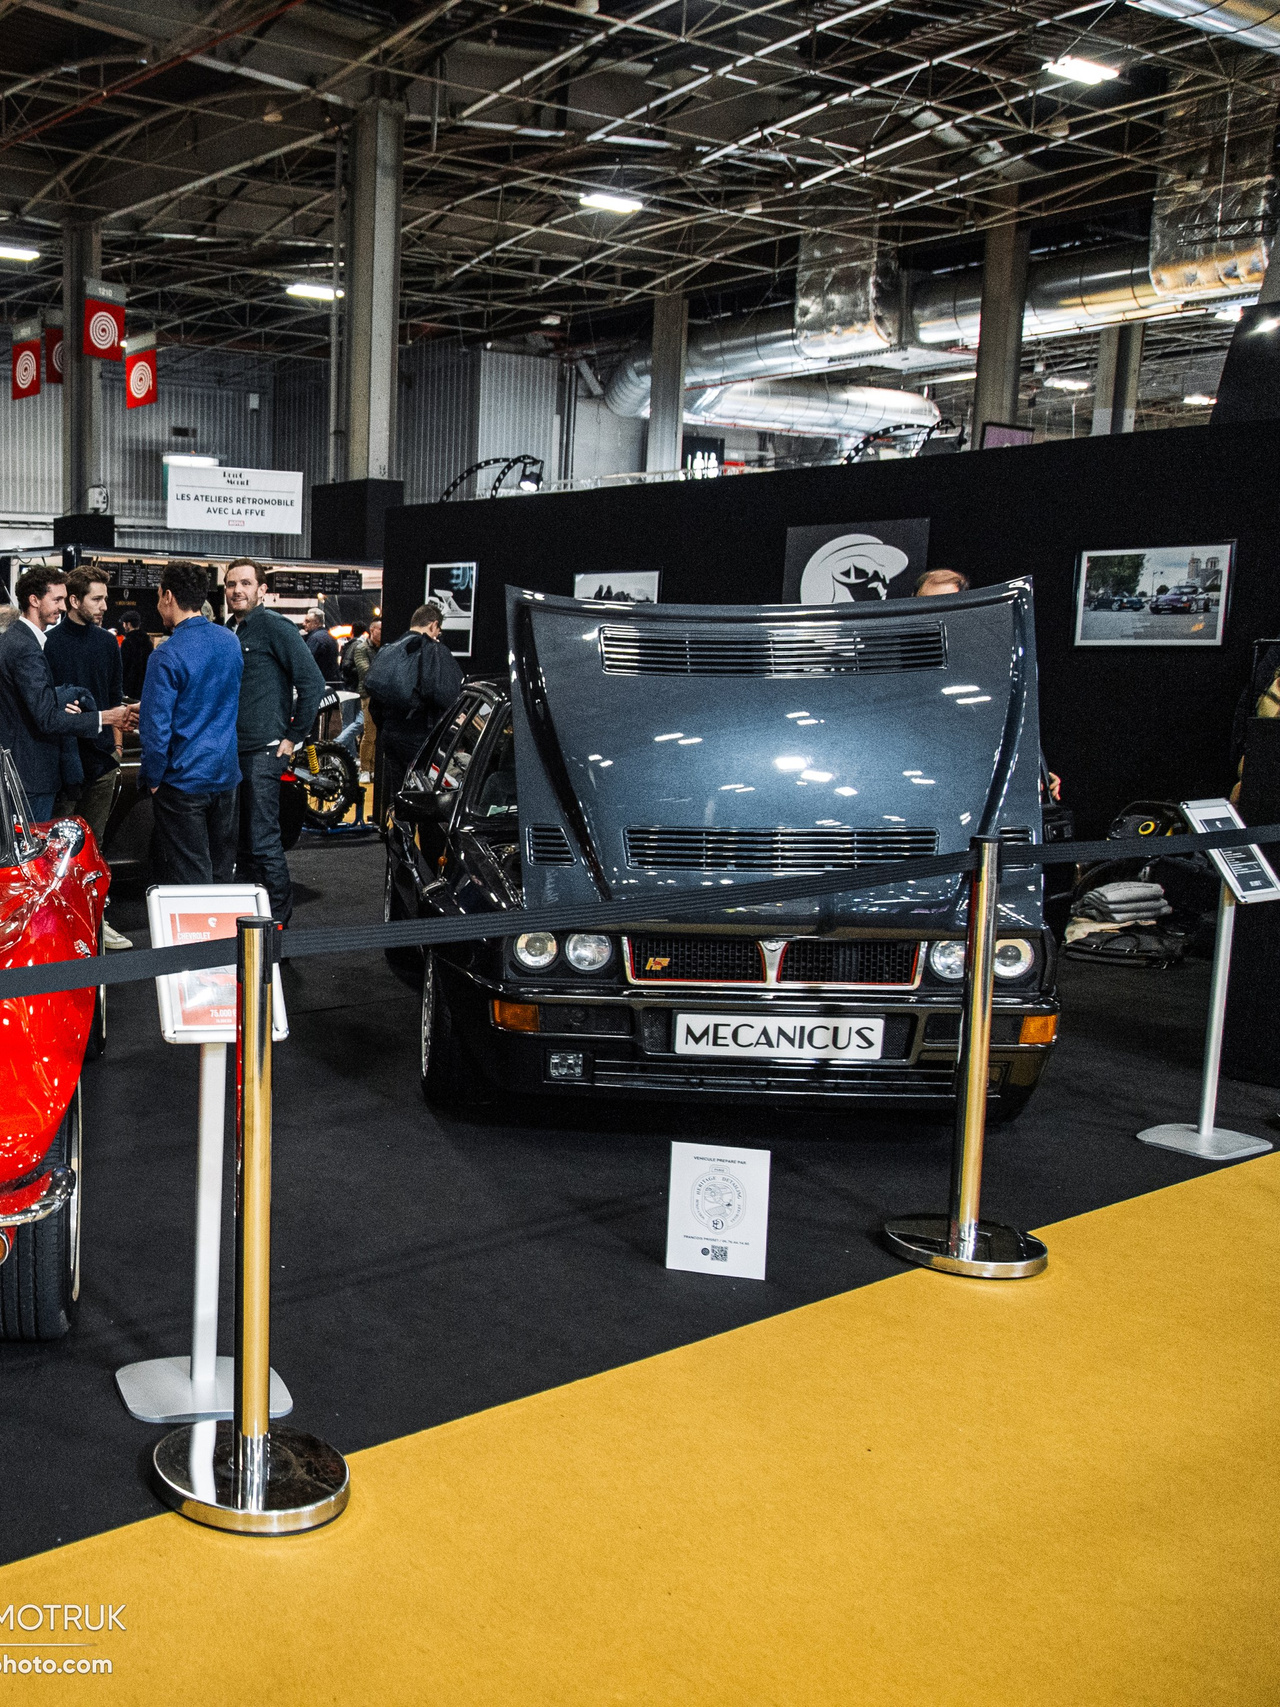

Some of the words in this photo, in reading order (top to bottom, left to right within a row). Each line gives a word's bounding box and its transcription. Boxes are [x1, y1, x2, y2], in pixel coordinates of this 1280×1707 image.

[176, 493, 191, 501] LES
[194, 494, 234, 503] ATELIERS
[236, 495, 295, 506] RÉTROMOBILE
[206, 506, 229, 515] AVEC
[231, 508, 242, 516] LA
[245, 508, 266, 517] FFVE
[177, 932, 210, 940] CHEVROLET
[685, 1022, 875, 1050] MECANICUS
